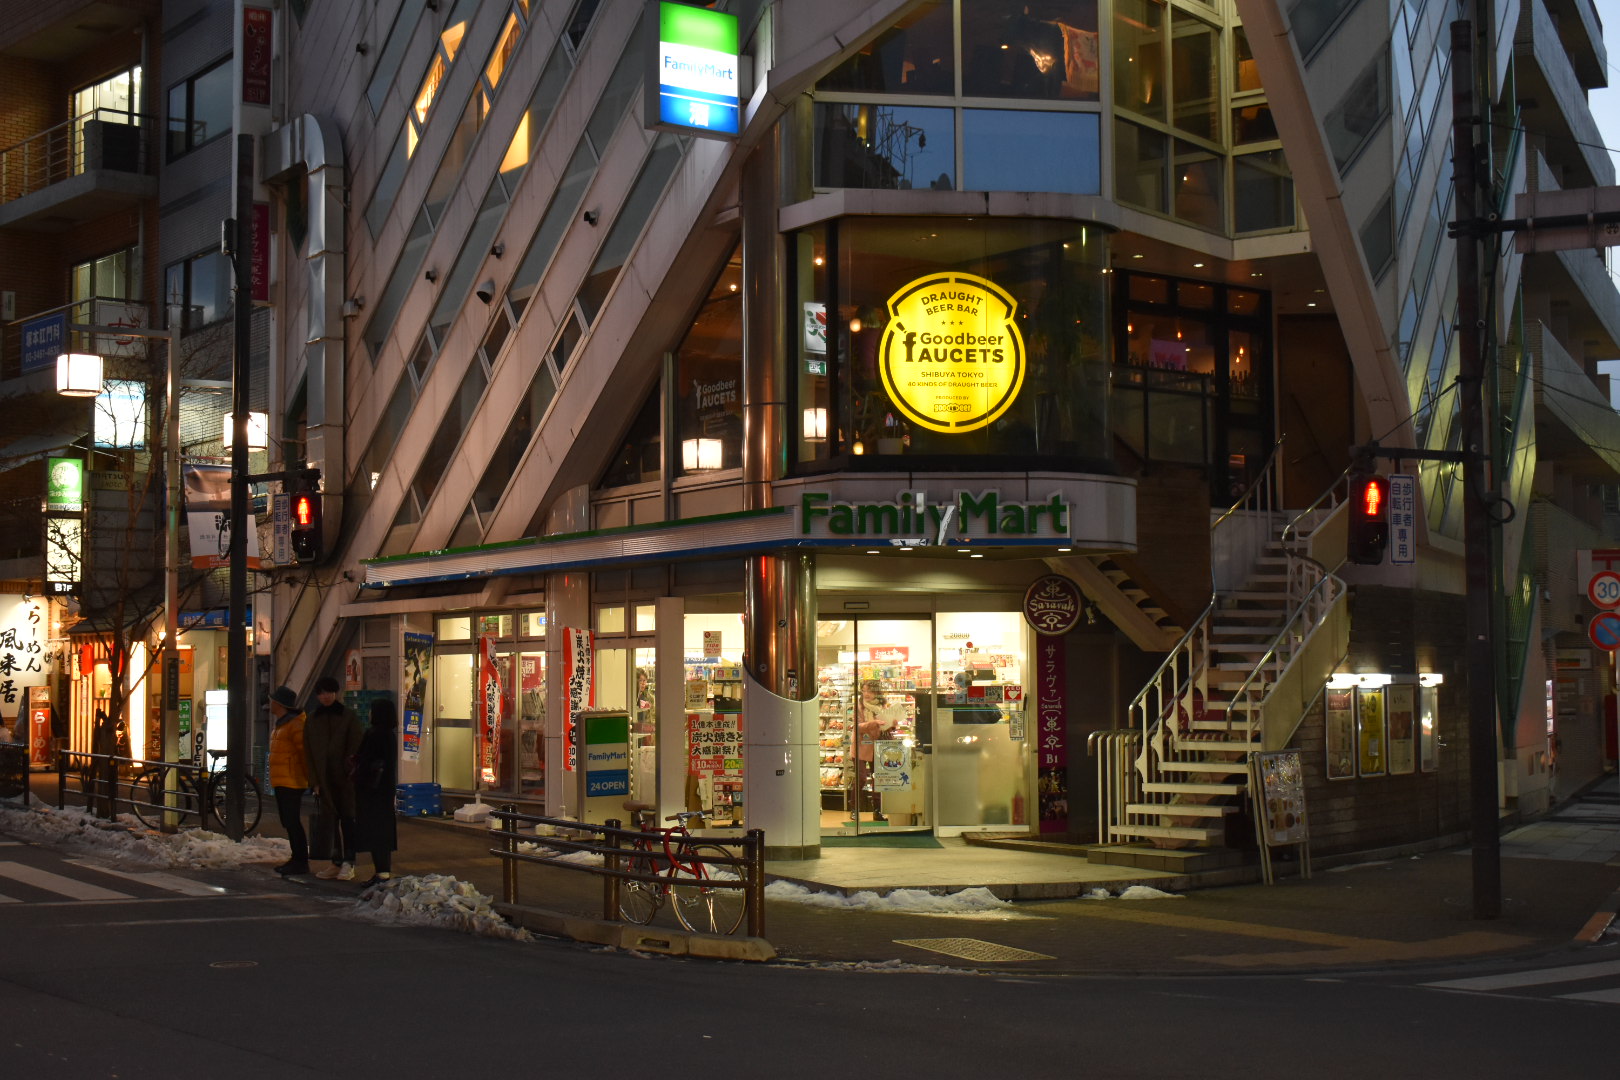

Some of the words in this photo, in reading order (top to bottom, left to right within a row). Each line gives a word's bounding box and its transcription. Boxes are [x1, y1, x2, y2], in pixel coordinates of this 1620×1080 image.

[664, 55, 733, 80] FamilyMart
[920, 291, 983, 306] DRAUGHT
[926, 303, 954, 316] BEER
[956, 304, 979, 317] BAR
[920, 332, 1004, 346] Goodbeer
[921, 371, 956, 379] SHIBUYA
[957, 371, 984, 379] TOKYO
[702, 379, 736, 394] Goodbeer
[1391, 481, 1402, 526] 自転車
[1402, 482, 1413, 527] 歩行者
[802, 491, 1068, 546] FamilyMart
[1398, 528, 1408, 558] 専用
[1597, 581, 1619, 599] 30
[1029, 600, 1075, 612] Saravah
[26, 606, 42, 673] らーめん
[1045, 644, 1057, 697] サラヴァ
[33, 711, 47, 762] らーめん
[588, 750, 627, 762] FamilyMart
[1045, 753, 1058, 764] B1
[590, 781, 601, 792] 24
[601, 780, 627, 791] OPEN
